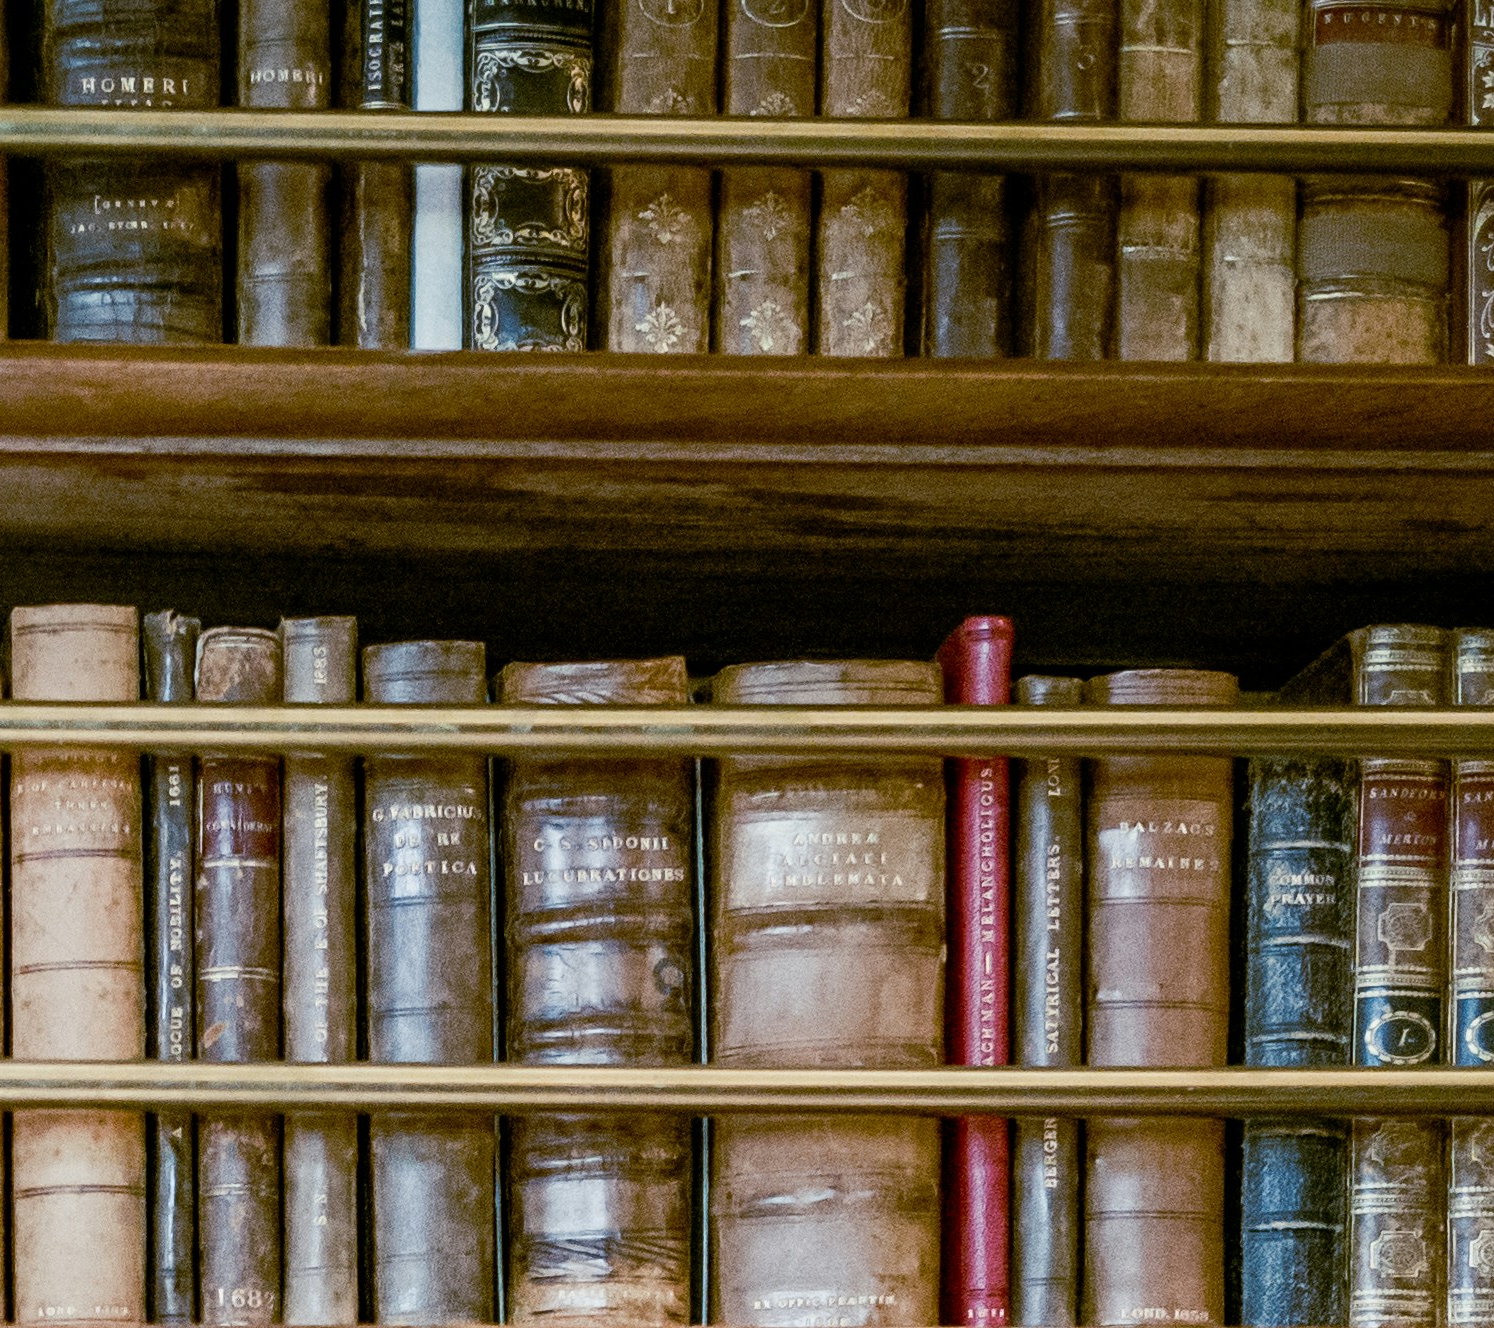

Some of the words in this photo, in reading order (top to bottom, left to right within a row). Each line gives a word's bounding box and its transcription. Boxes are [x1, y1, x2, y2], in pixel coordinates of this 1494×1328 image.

[82, 77, 188, 94] HOMERI
[170, 965, 183, 988] OF
[1046, 948, 1060, 1053] SATYRICAL
